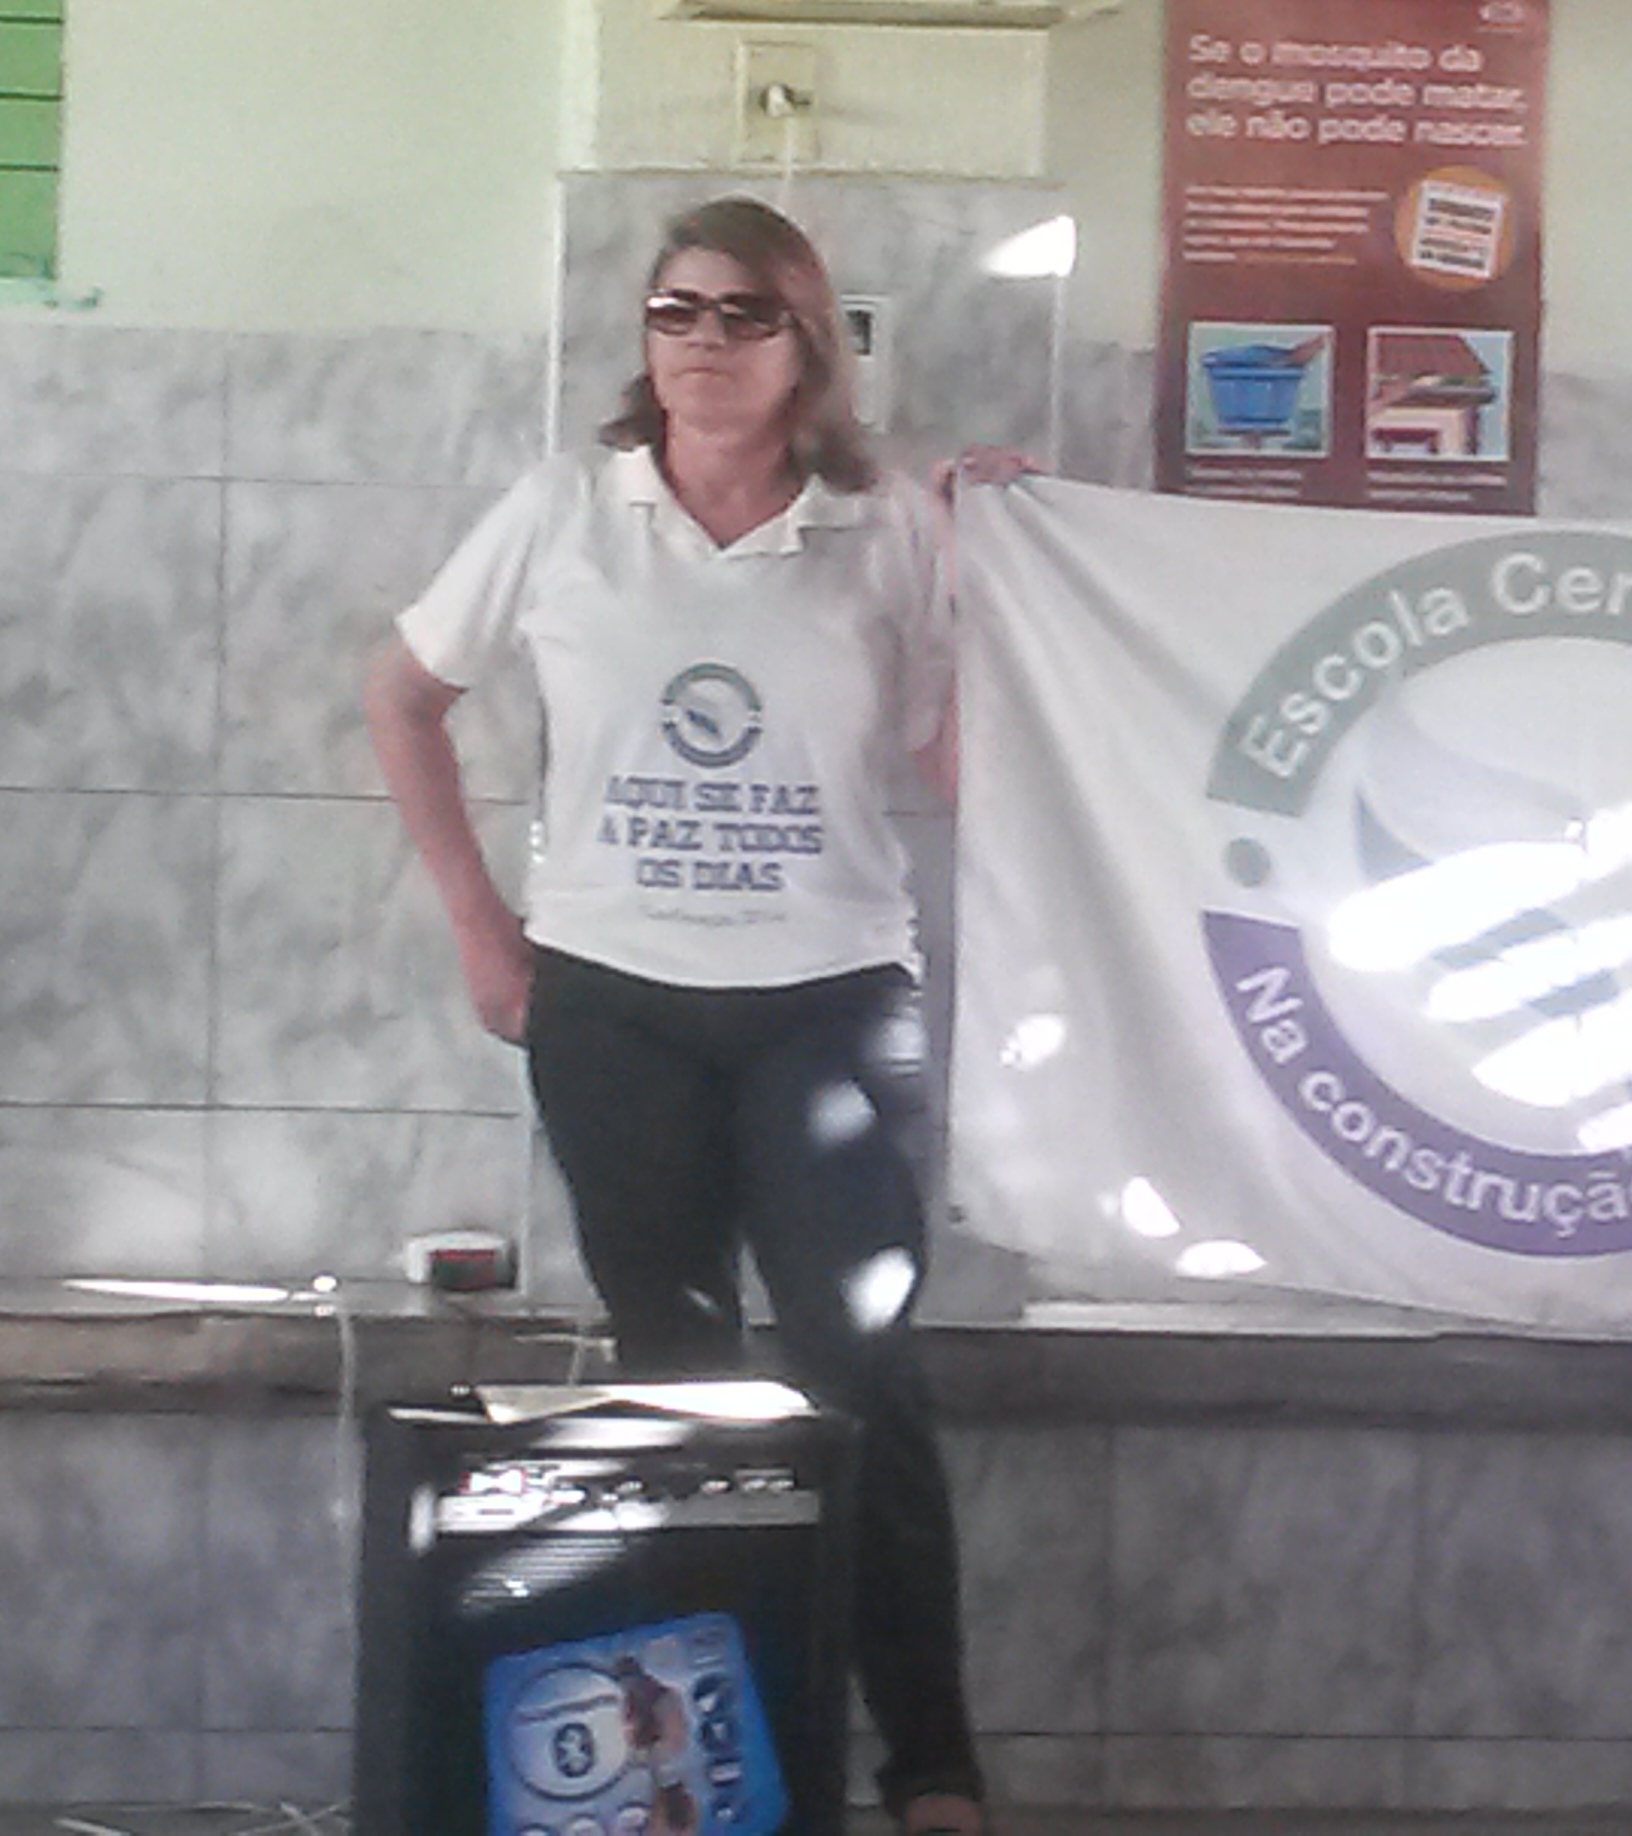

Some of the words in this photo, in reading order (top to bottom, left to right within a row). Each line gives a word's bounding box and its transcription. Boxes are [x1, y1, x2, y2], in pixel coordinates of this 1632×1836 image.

[1188, 34, 1230, 63] Se
[1239, 42, 1265, 64] o
[1271, 40, 1433, 70] mosquito
[1438, 44, 1485, 72] da
[1186, 73, 1316, 106] dengue
[1324, 78, 1417, 108] pode
[1185, 110, 1237, 138] ele
[1245, 110, 1311, 140] não
[1318, 114, 1407, 144] pode
[1238, 589, 1471, 780] Escola
[605, 775, 686, 809] AQUI
[694, 783, 741, 812] SE
[749, 784, 819, 815] FAZ
[597, 816, 620, 845] A
[626, 816, 703, 851] PAZ
[713, 823, 823, 854] TODOS
[636, 857, 682, 888] OS
[692, 861, 783, 890] DIAS
[1236, 963, 1311, 1064] Na
